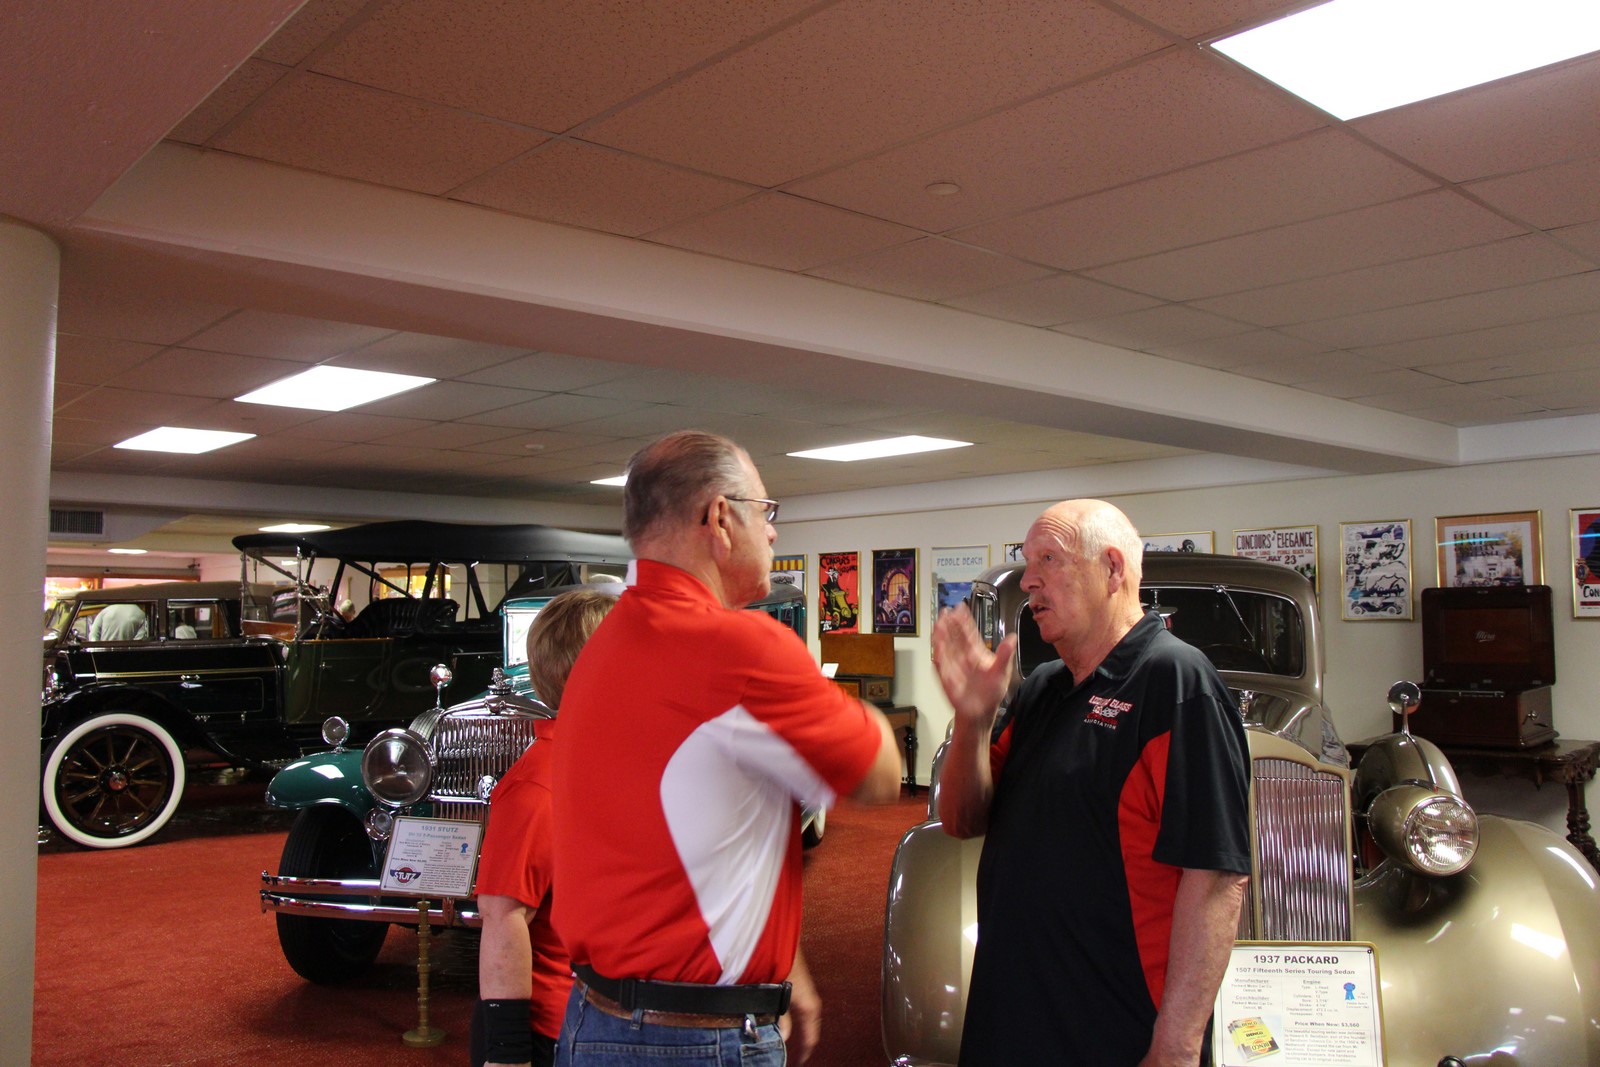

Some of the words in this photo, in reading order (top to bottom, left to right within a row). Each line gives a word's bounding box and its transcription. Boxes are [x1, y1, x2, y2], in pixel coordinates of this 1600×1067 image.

[1284, 555, 1296, 564] 23
[394, 872, 417, 880] STUTZ
[1254, 955, 1280, 964] 1937
[1284, 956, 1339, 964] PACKARD
